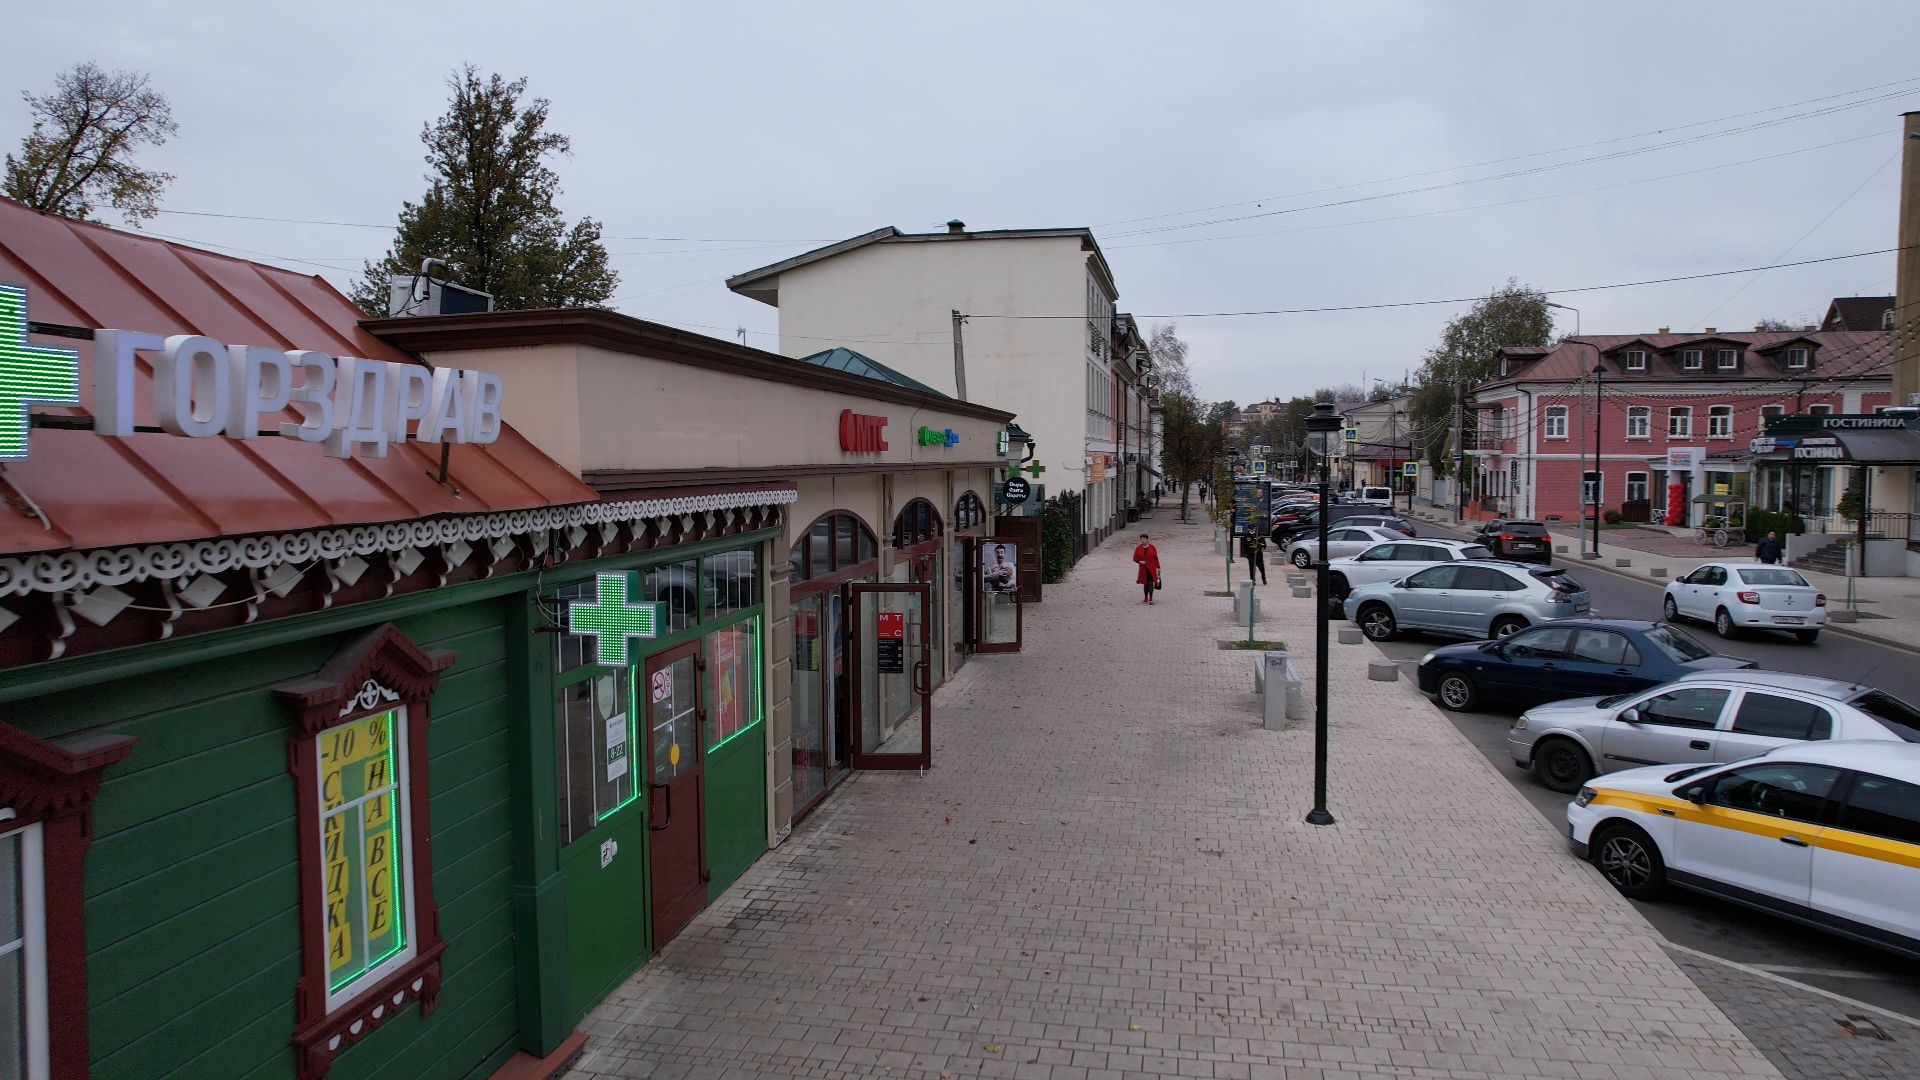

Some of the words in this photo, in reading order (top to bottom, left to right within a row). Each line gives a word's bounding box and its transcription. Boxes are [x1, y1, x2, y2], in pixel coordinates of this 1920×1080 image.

[94, 329, 504, 459] ГОРЗДРАВ
[853, 414, 889, 452] МТС
[1823, 418, 1906, 428] ГОСТИНИЦА
[1794, 447, 1843, 459] ГОСТИНИЦА
[321, 727, 355, 763] -10
[369, 717, 387, 750] %
[366, 759, 386, 824] НА
[322, 770, 345, 962] СКИДКА
[368, 835, 388, 934] ВСЁ
